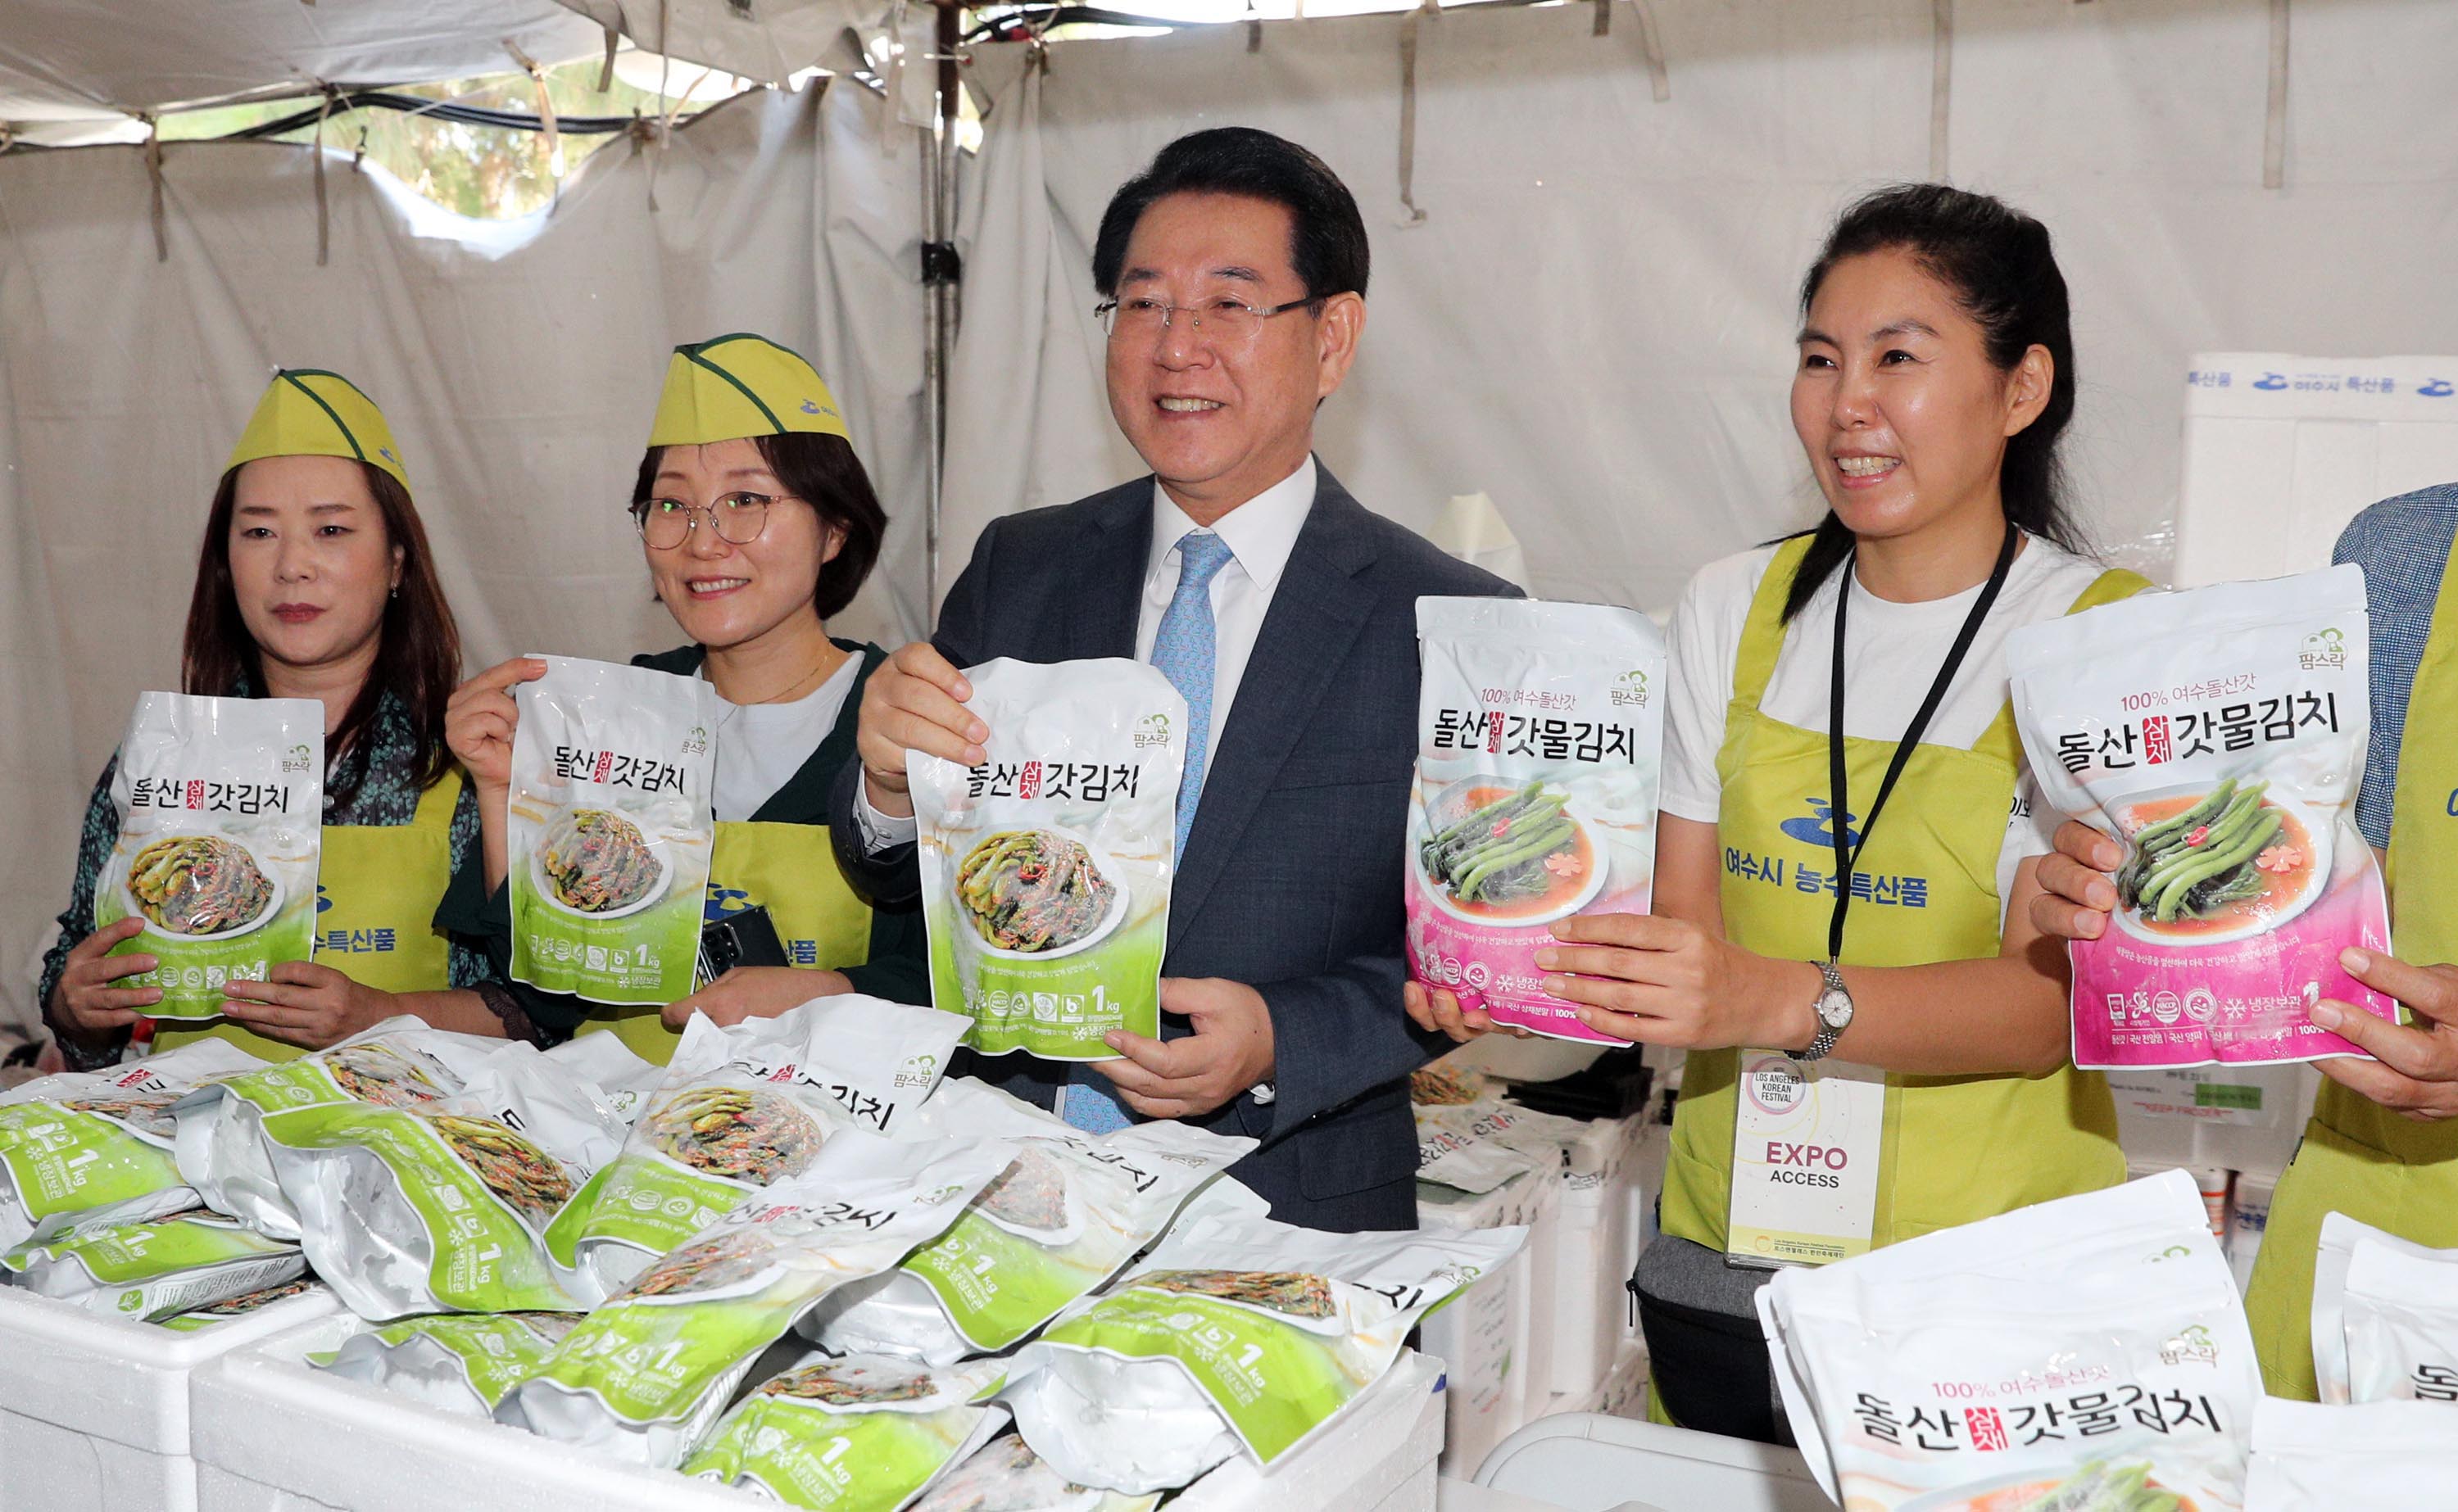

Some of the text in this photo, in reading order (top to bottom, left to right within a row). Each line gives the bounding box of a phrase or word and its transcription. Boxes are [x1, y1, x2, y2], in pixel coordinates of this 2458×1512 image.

[1481, 687, 1576, 712] 100% 여수돌산갓
[2120, 672, 2256, 712] 100% 여수돌산갓
[1433, 708, 1490, 749] 돌산
[1508, 715, 1635, 765] 갓물김치
[2057, 724, 2137, 774] 돌산
[2175, 689, 2339, 760] 갓물김치
[554, 746, 596, 781] 돌산
[613, 754, 686, 795] 갓김치
[966, 763, 1019, 799] 돌산
[1045, 763, 1140, 803] 갓김치
[131, 776, 184, 808] 돌산
[208, 783, 288, 813] 갓김치
[1726, 846, 1784, 887] 여수시
[1554, 1008, 1576, 1020] 100%
[1755, 1072, 1800, 1085] LOS ANGELES
[1762, 1083, 1792, 1093] KOREAN
[1761, 1092, 1792, 1103] FESTIVAL
[1766, 1141, 1848, 1170] EXPO
[1770, 1170, 1839, 1188] ACCESS
[1931, 1381, 1996, 1398] 100%
[1853, 1392, 1960, 1451] 돌산
[2008, 1384, 2223, 1446] 갓물김치
